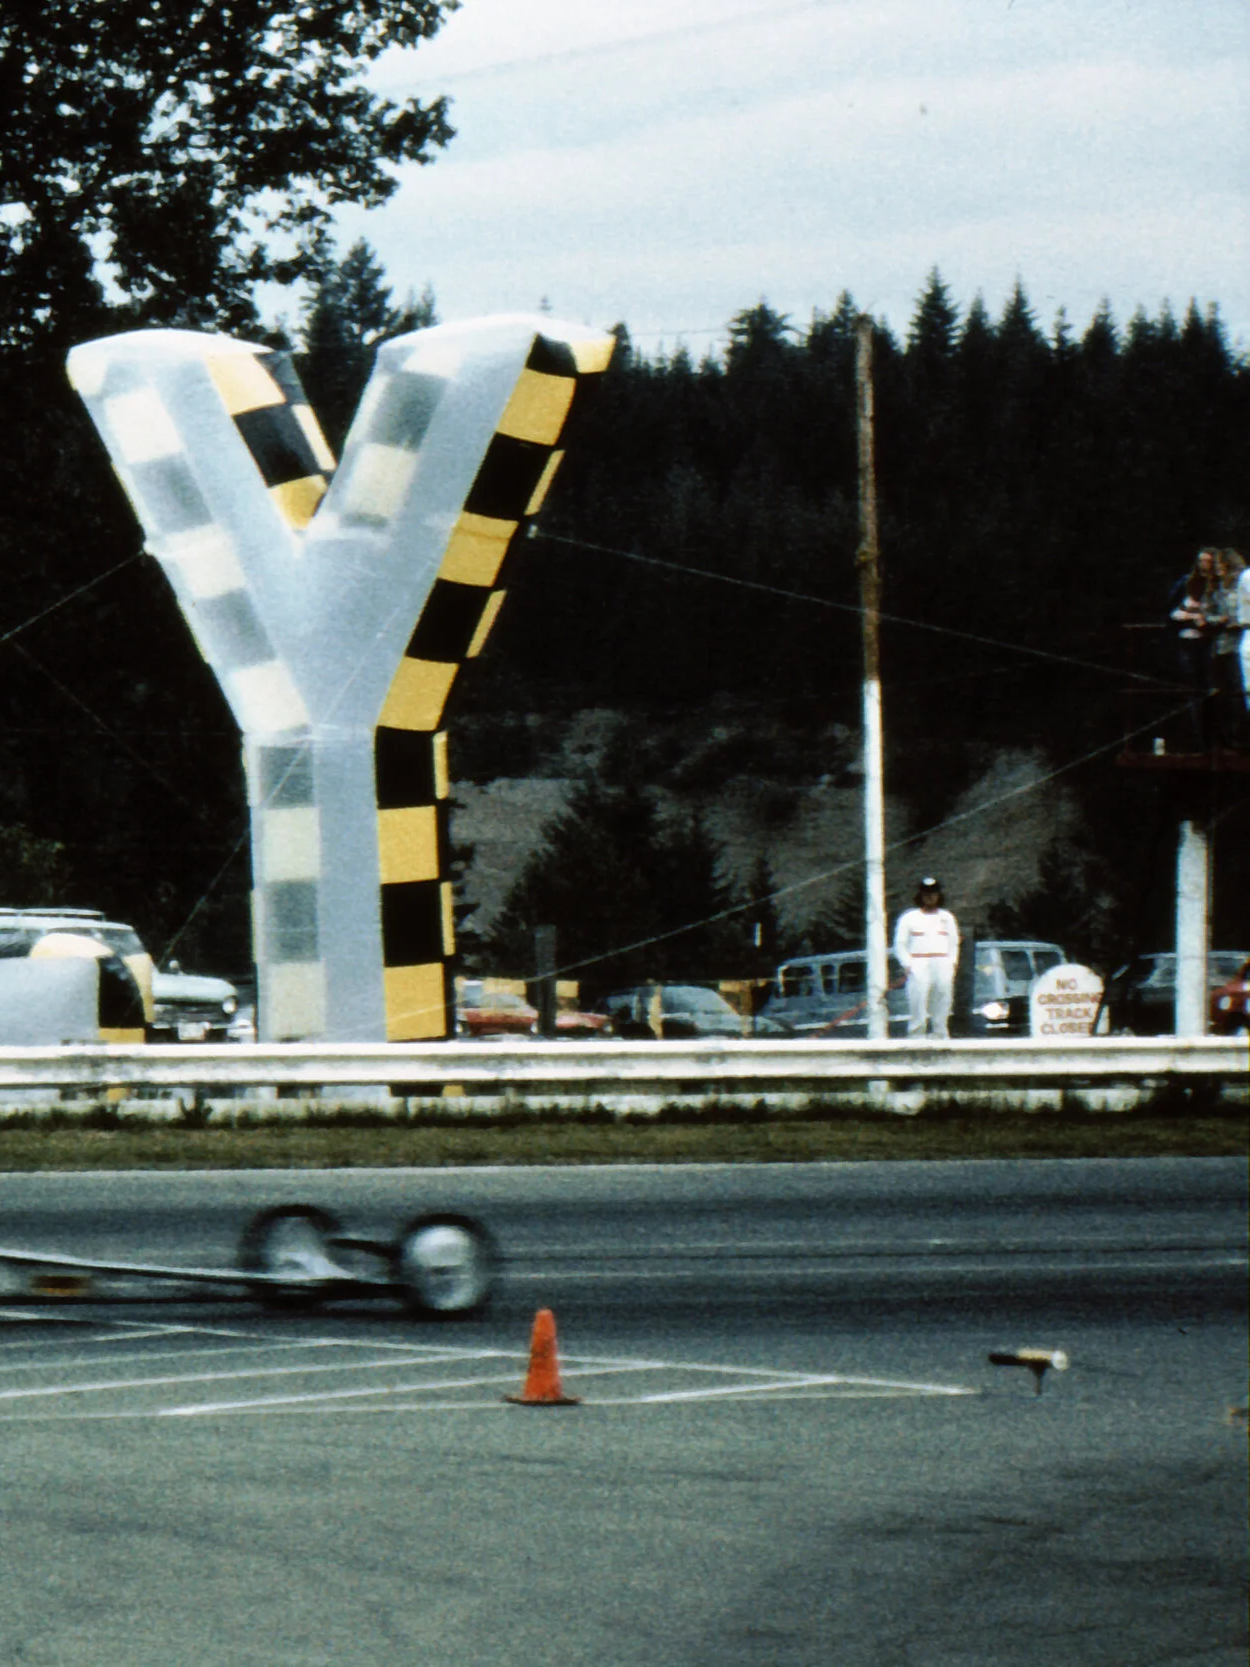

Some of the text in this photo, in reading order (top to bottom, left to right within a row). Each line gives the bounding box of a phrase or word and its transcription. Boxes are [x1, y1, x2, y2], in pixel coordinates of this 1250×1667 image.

[1056, 979, 1076, 990] NO
[1037, 993, 1102, 1005] CROSSING
[1046, 1008, 1094, 1018] TRACK
